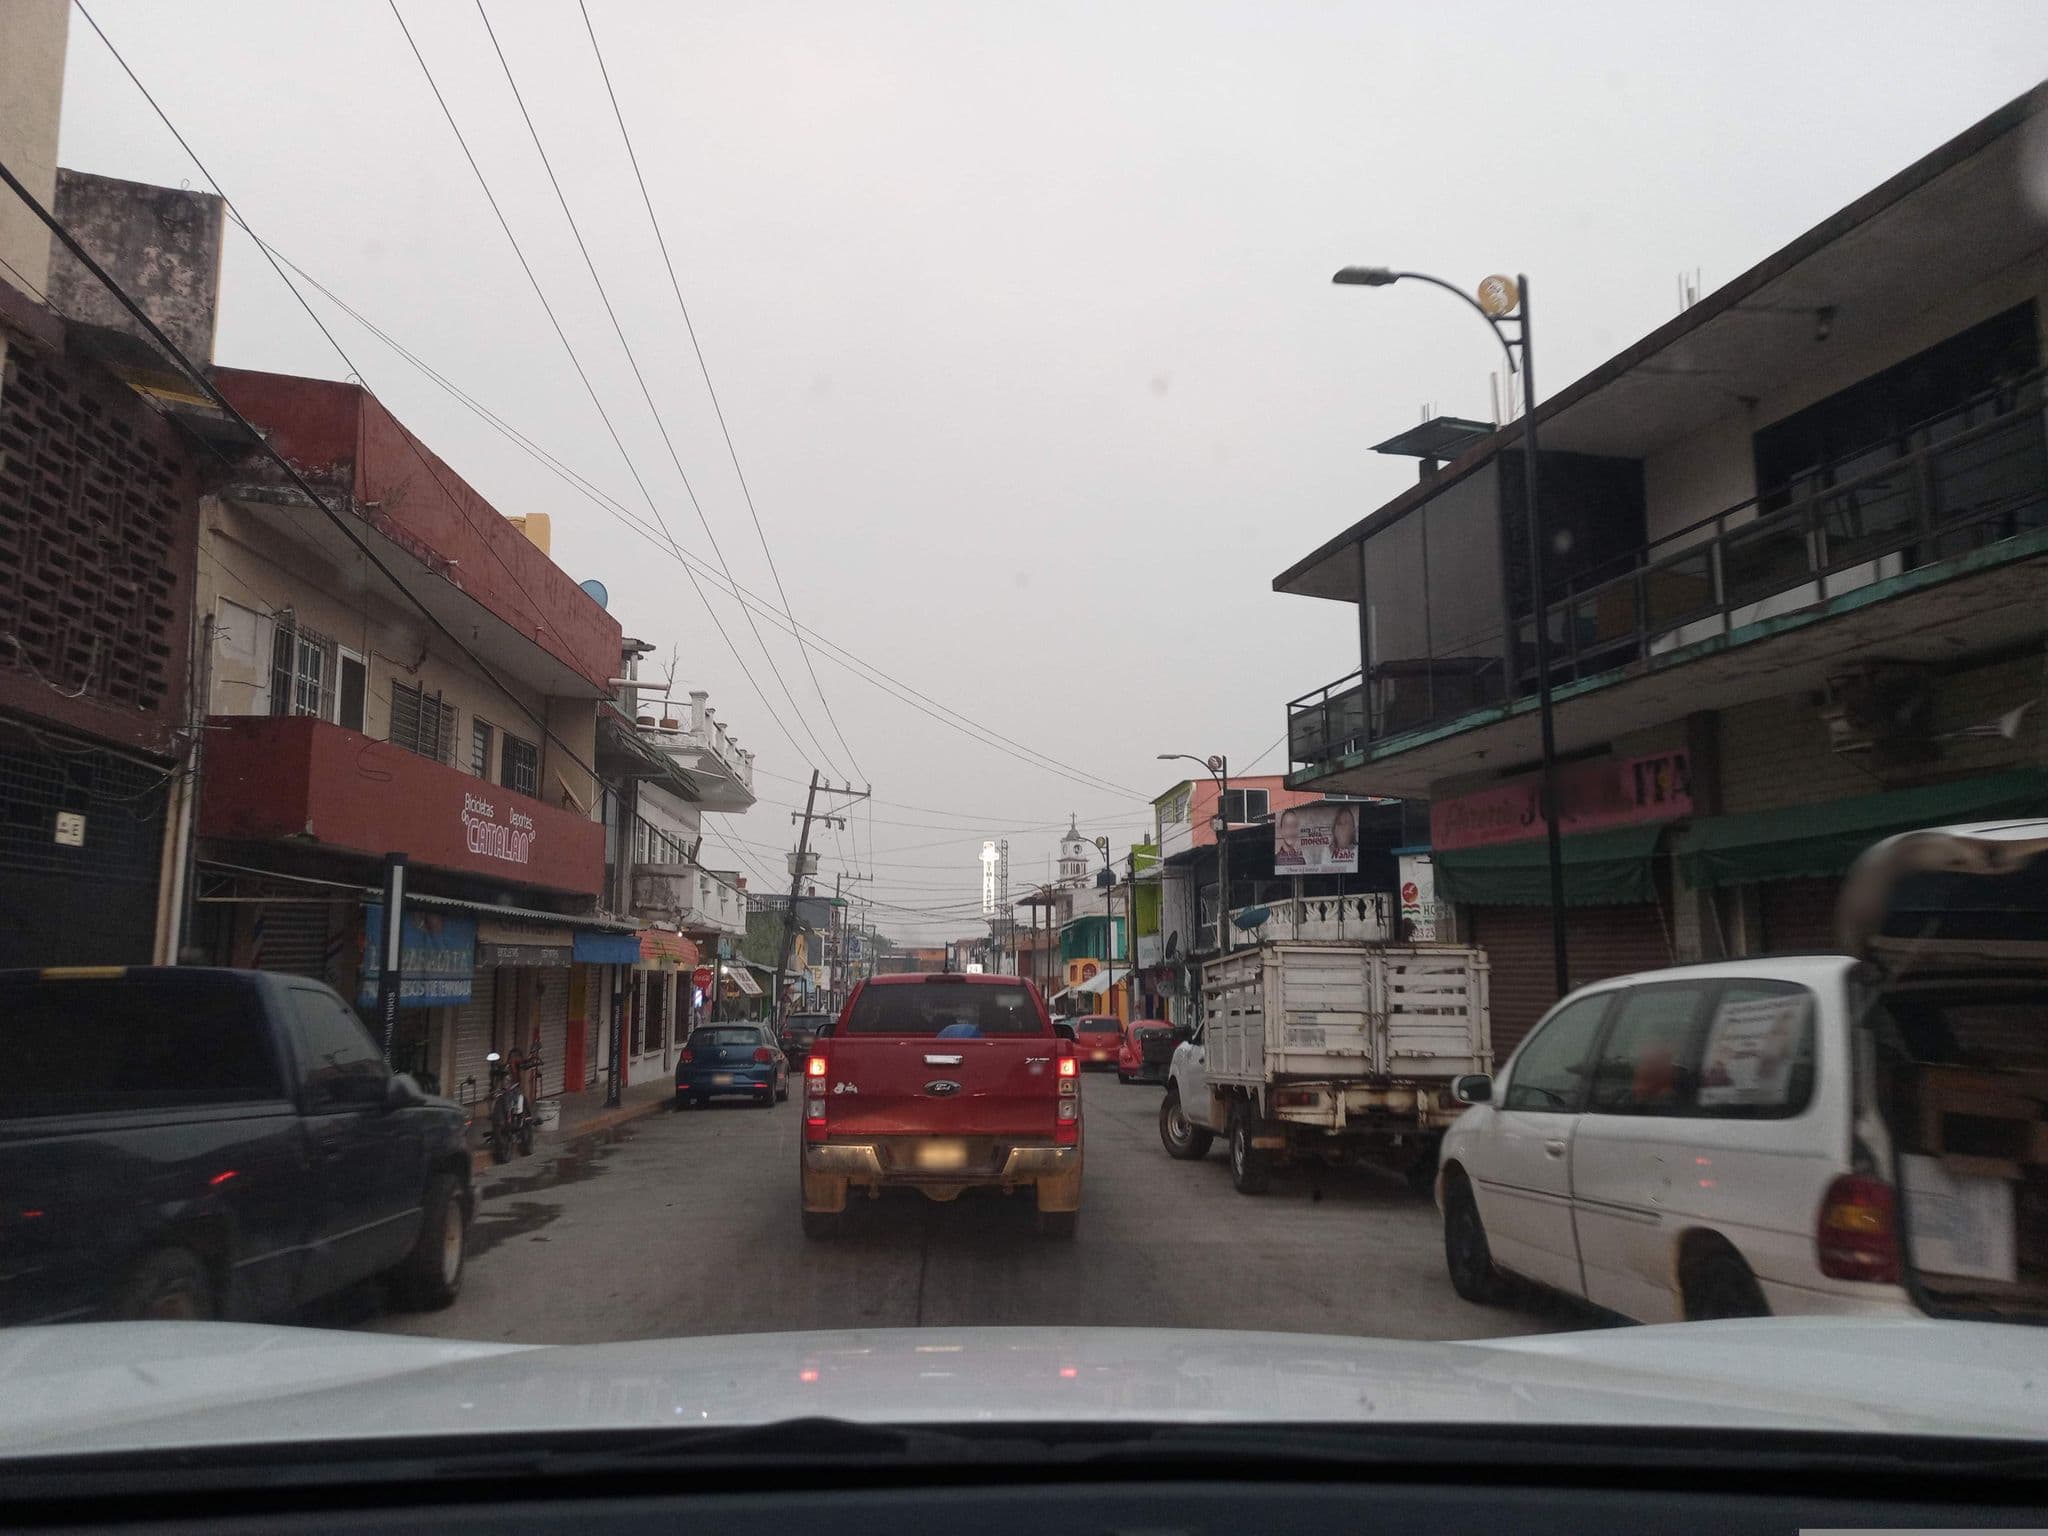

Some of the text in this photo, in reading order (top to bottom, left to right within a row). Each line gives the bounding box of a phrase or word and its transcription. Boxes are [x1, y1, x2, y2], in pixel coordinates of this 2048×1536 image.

[464, 792, 533, 830] Bicicletas Deportes
[467, 818, 529, 864] CATALAN
